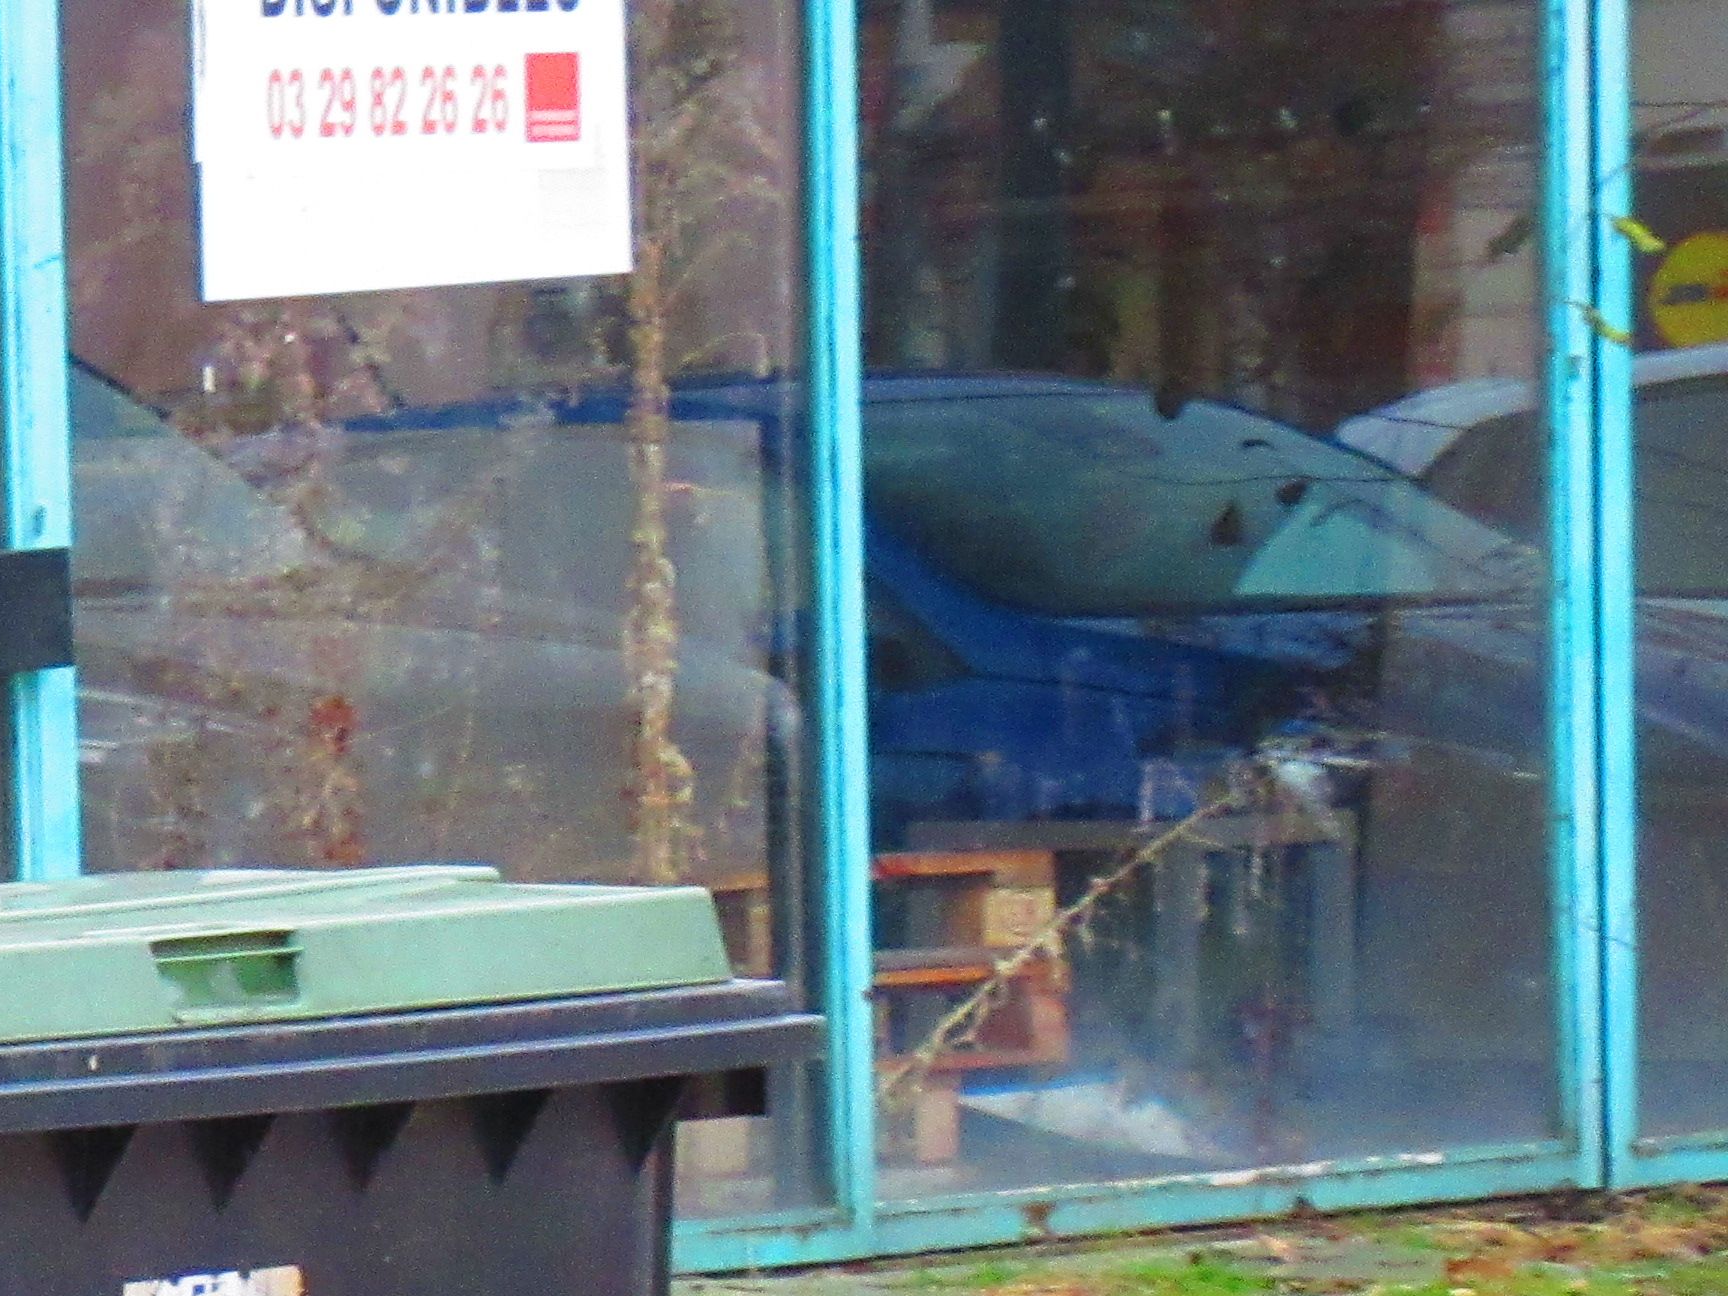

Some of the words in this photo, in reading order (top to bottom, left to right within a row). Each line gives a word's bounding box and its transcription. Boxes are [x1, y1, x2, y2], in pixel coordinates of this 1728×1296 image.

[267, 68, 306, 138] 03
[318, 67, 357, 137] 29
[370, 66, 408, 136] 82
[420, 65, 458, 135] 26
[471, 64, 508, 134] 26
